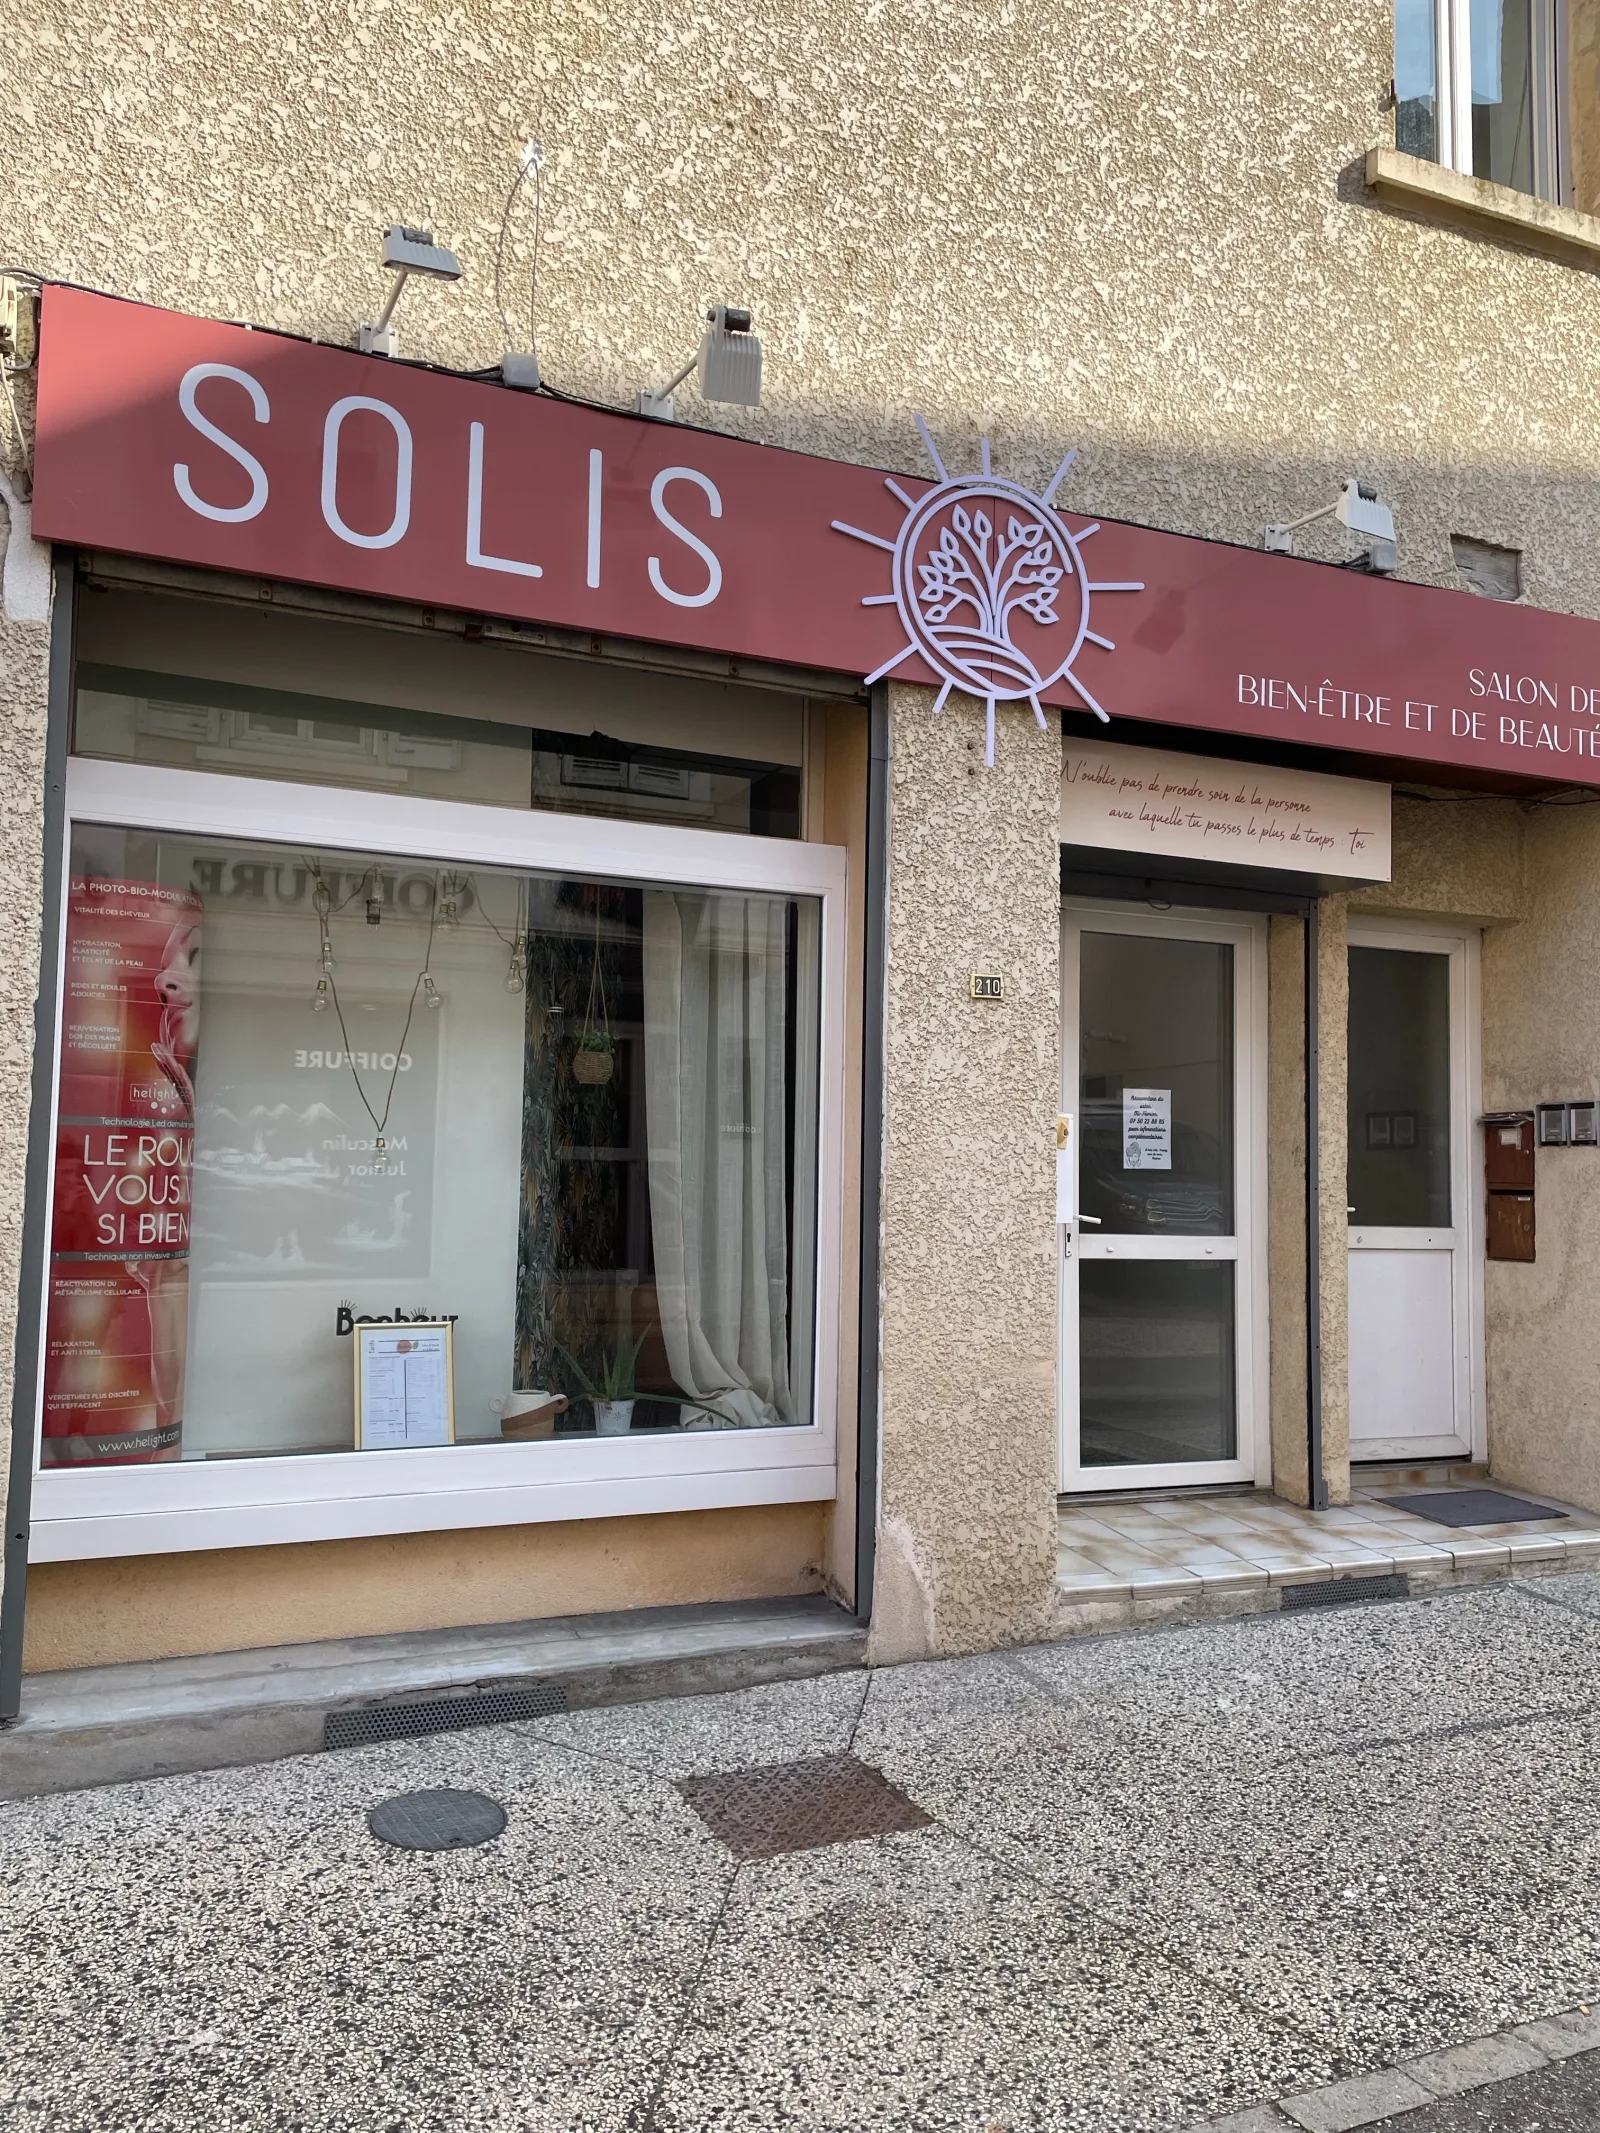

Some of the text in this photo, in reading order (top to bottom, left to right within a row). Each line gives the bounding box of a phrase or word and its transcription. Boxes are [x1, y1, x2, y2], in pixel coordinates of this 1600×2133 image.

[174, 363, 723, 608] SOLIS
[1469, 668, 1600, 716] SALON DE
[1238, 673, 1600, 758] BIEN-ÊTRE ET DE BEAUTÉ
[1060, 760, 1312, 814] N'oublie pas de prendre soin de la personne
[1109, 808, 1134, 821] avec
[1139, 802, 1184, 832] laquelle
[1185, 812, 1203, 828] tu
[1203, 820, 1242, 837] passes
[1247, 816, 1257, 835] le
[1259, 819, 1285, 843] plus
[1290, 823, 1302, 841] de
[1303, 828, 1335, 851] temps
[72, 881, 86, 891] LA
[74, 905, 151, 919] VITALITÉ DES CHEVEUX
[71, 982, 90, 990] RIDES
[975, 979, 1000, 994] 210
[100, 1116, 151, 1128] Technologie
[151, 1118, 166, 1128] Led
[84, 1134, 128, 1166] LE
[82, 1173, 181, 1205] VOUS
[97, 1212, 190, 1245] SI BIEN
[84, 1252, 127, 1262] Technique
[128, 1253, 144, 1261] non
[144, 1252, 170, 1260] invasive
[55, 1280, 106, 1288] RÉACTIVATION
[51, 1340, 95, 1348] RELAXATION
[48, 1393, 90, 1401] VERGETURES
[98, 1430, 179, 1452] www.helight.com
